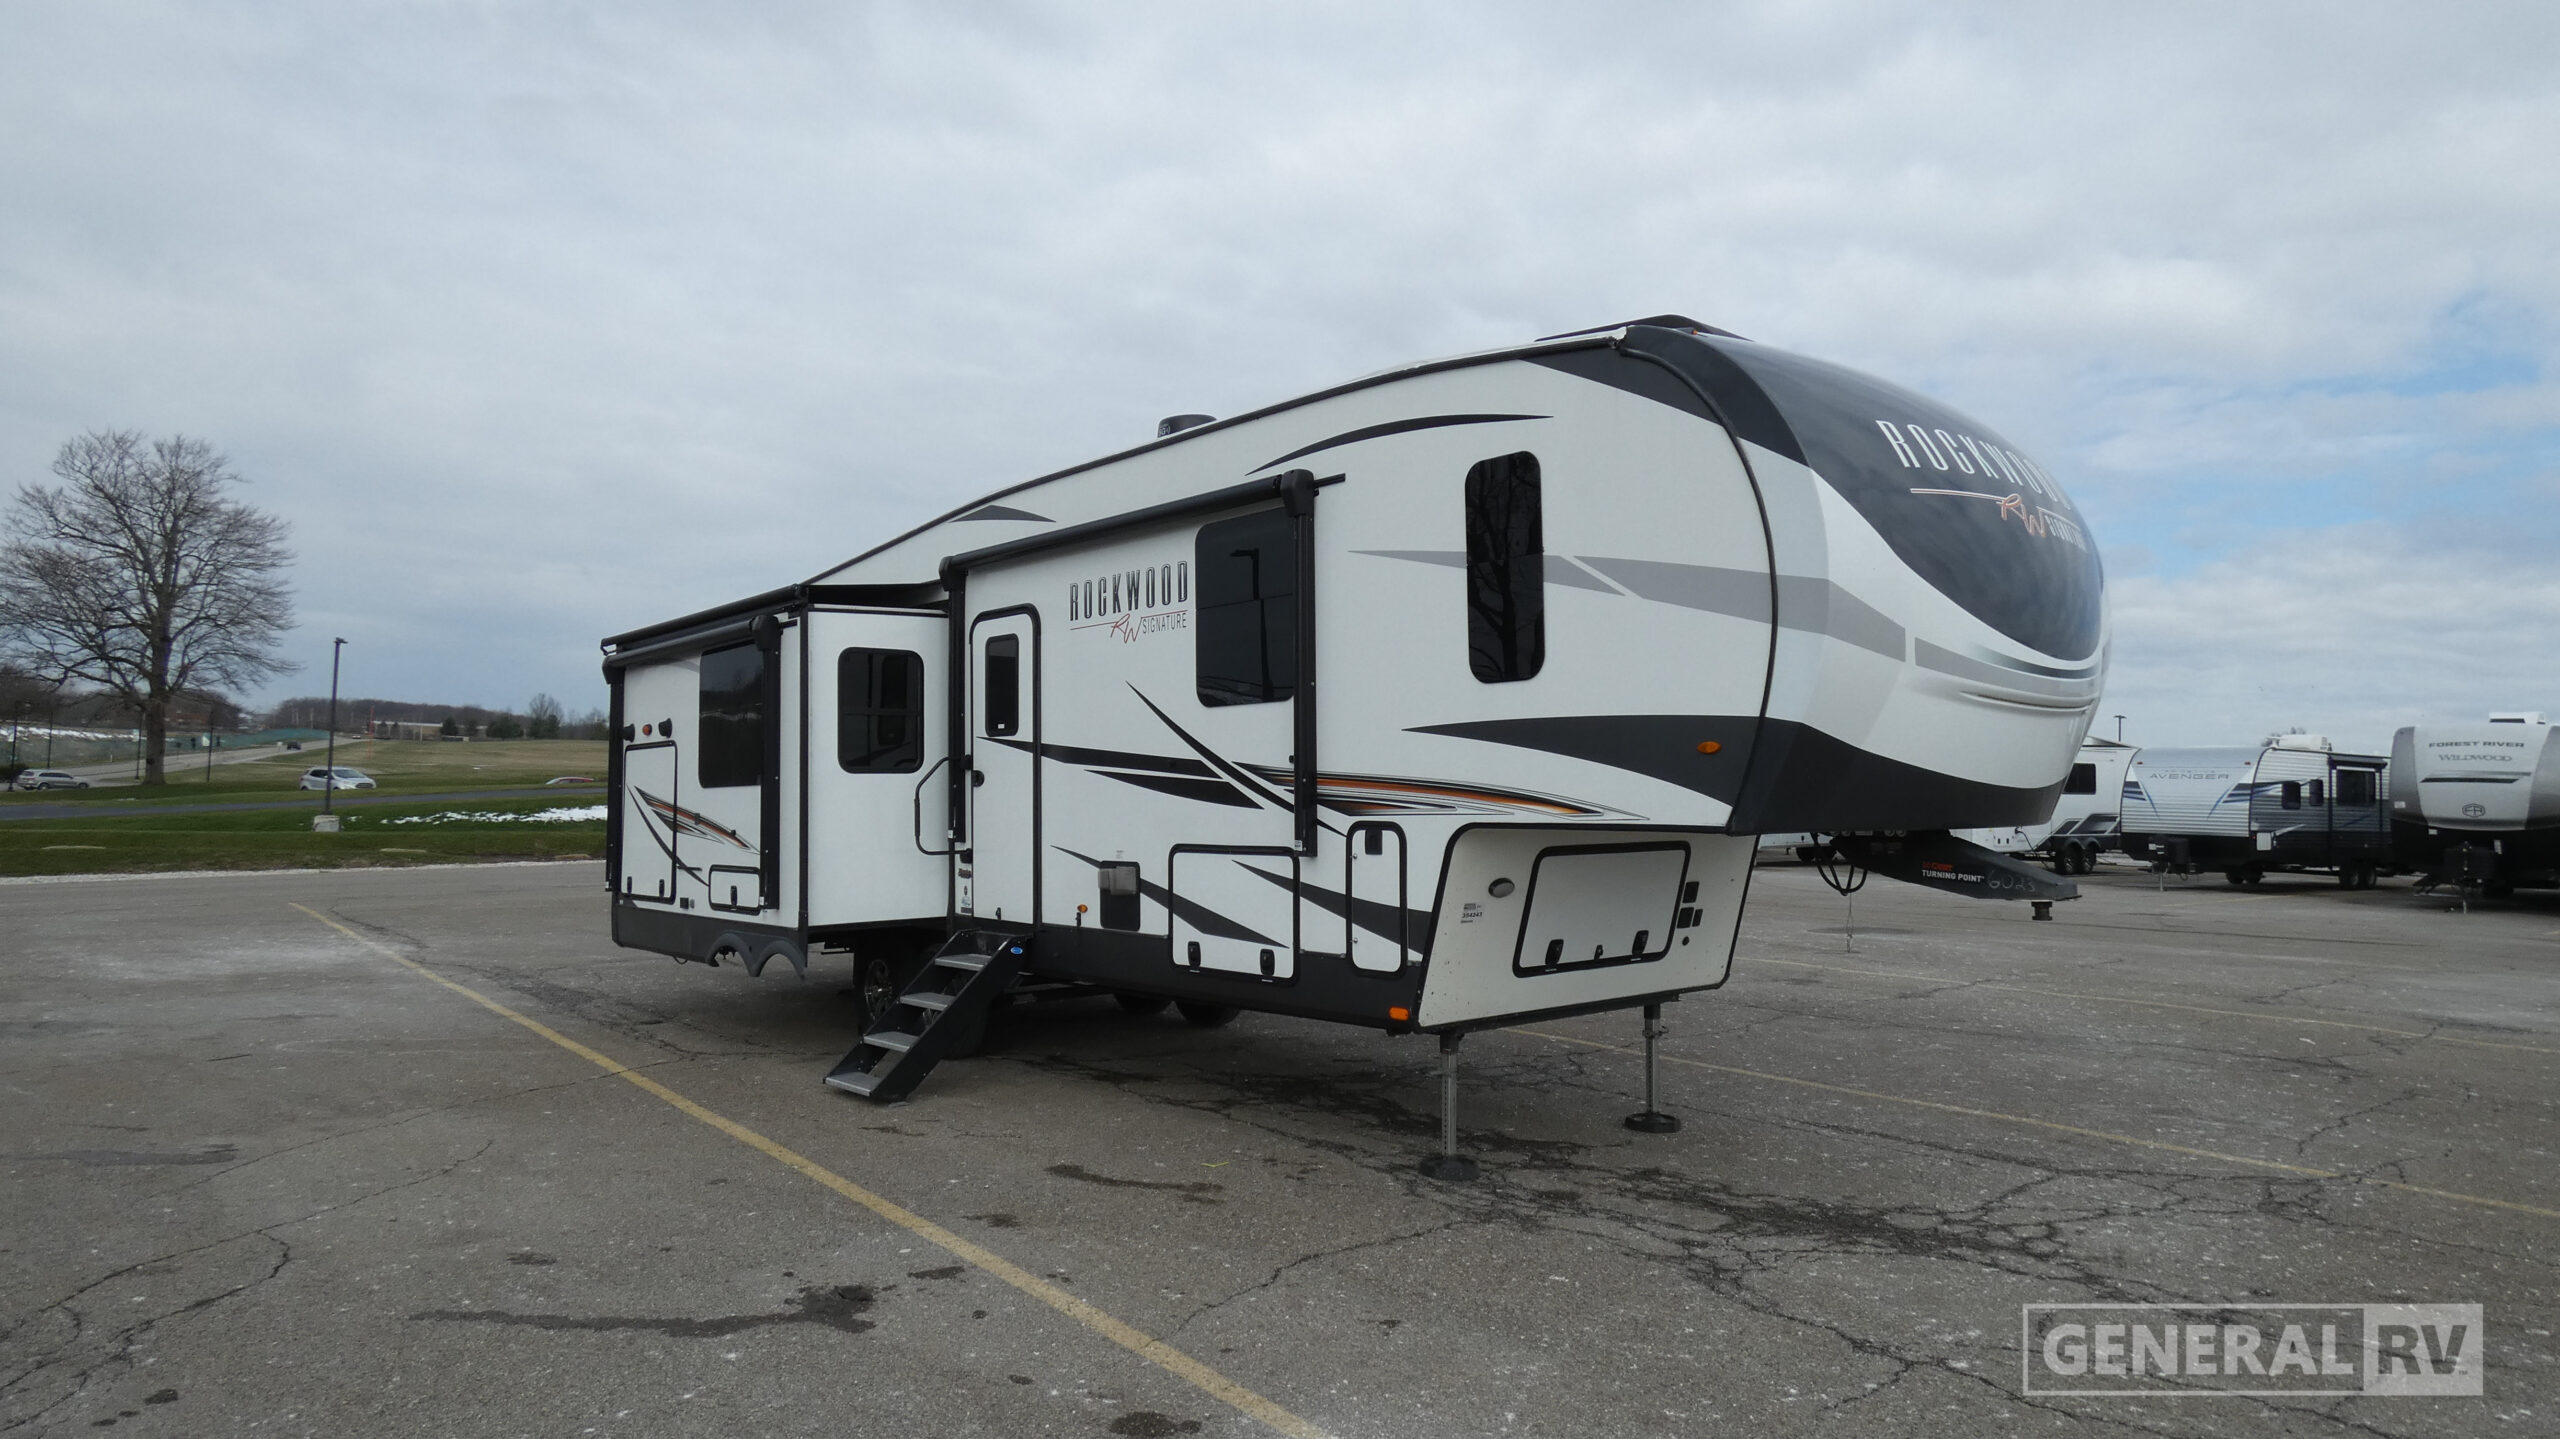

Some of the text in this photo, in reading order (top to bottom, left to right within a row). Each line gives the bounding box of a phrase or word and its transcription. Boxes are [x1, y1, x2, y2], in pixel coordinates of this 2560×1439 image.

[1069, 560, 1188, 621] ROCKWOOD
[1142, 612, 1187, 634] SIGNATURE
[1922, 869, 1982, 883] TURNING POINT
